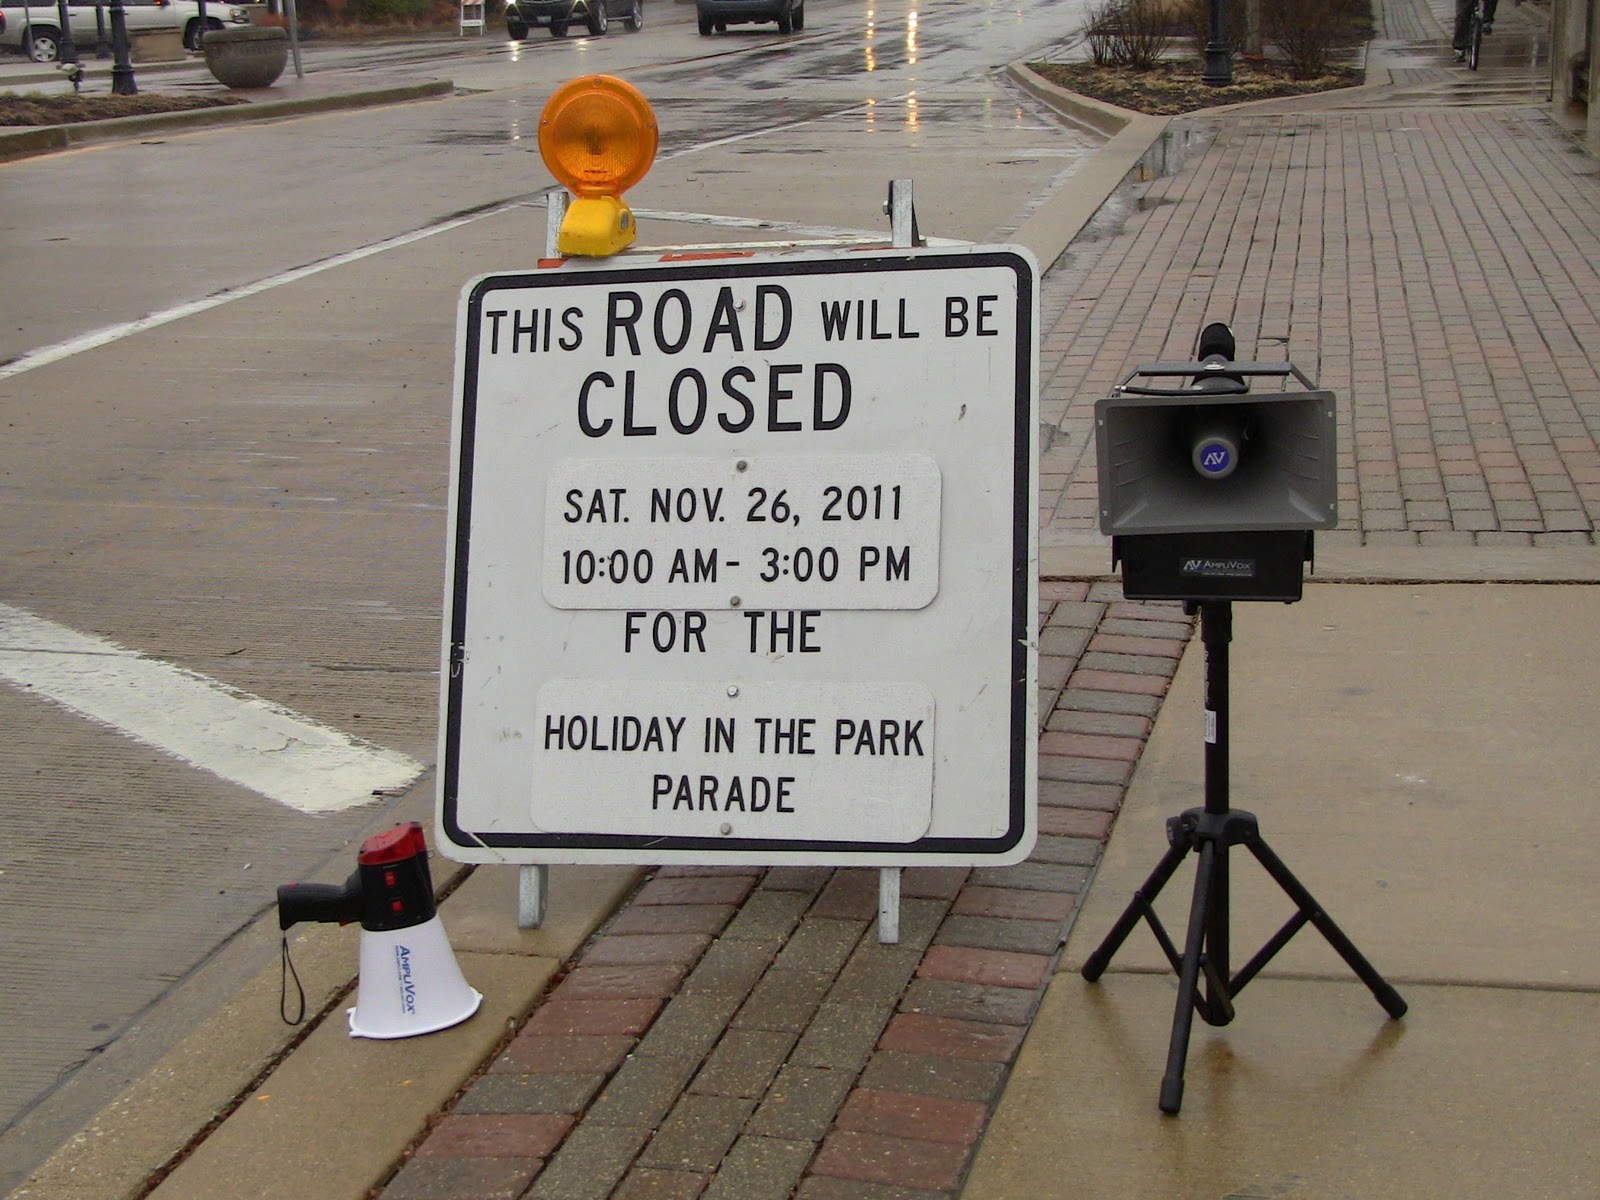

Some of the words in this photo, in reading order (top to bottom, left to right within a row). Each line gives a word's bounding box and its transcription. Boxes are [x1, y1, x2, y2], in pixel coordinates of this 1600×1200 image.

[485, 306, 584, 355] THIS
[604, 284, 793, 357] ROAD
[820, 298, 920, 342] WILL
[943, 294, 1000, 339] BE
[577, 362, 853, 438] CLOSED
[563, 487, 630, 524] SAT.
[649, 487, 726, 524] NOV.
[746, 486, 801, 527] 26,
[821, 484, 903, 522] 2011
[562, 548, 655, 586] 10:00
[758, 546, 840, 584] 3:00
[858, 545, 911, 583] PM
[623, 609, 708, 655] FOR
[743, 609, 823, 654] THE
[543, 713, 687, 753] HOLIDAY
[703, 716, 737, 755] IN
[754, 716, 818, 756] THE
[834, 717, 925, 757] PARK
[651, 773, 797, 815] PARADE
